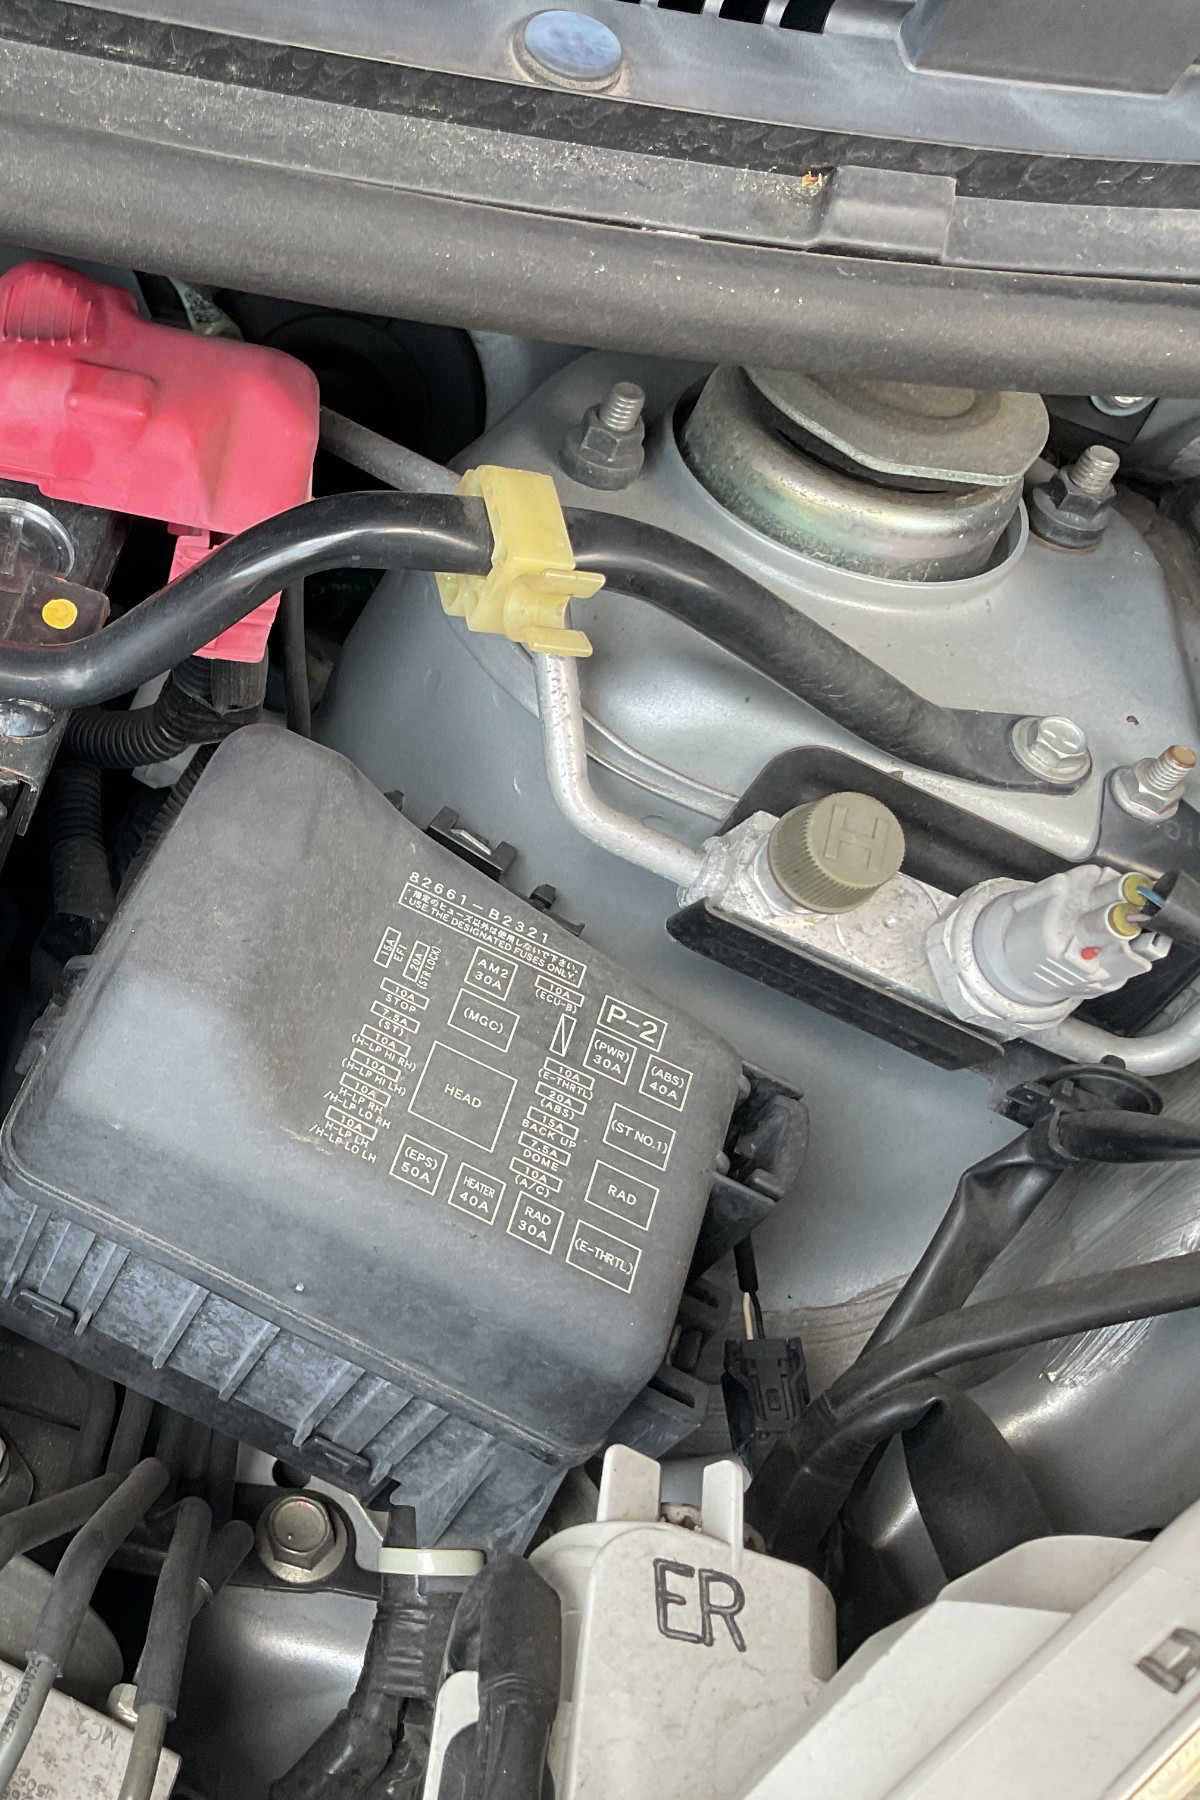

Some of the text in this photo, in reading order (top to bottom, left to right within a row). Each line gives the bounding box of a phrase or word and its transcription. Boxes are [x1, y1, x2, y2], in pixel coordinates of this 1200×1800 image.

[408, 898, 427, 913] USE
[431, 907, 449, 923] THE
[451, 916, 512, 952] DESIGNATED
[513, 945, 545, 967] FUSES
[381, 939, 396, 956] 15A
[393, 944, 408, 962] EFI
[410, 952, 423, 971] 20A
[416, 945, 441, 989] (STR LOCK)
[477, 959, 509, 979] AM2
[474, 970, 502, 990] 30A
[394, 986, 415, 1002] 10A
[535, 988, 577, 1014] (ECU-B)
[550, 983, 570, 1000] 10A
[385, 993, 417, 1013] STOP
[378, 1018, 404, 1037] (ST)
[383, 1008, 408, 1026] 7.5A
[463, 1007, 504, 1034] (MGC)
[606, 1004, 658, 1043] P-2
[375, 1033, 396, 1049] 10A
[594, 1039, 630, 1063] (PWR)
[351, 1033, 417, 1072] (H-LP HI RH)
[365, 1057, 387, 1074] 10A
[558, 1066, 580, 1082] 10A
[593, 1054, 621, 1074] 30A
[341, 1058, 406, 1097] (H-LP HI LH)
[538, 1068, 593, 1101] (E-THRTL)
[651, 1066, 685, 1088] (ABS)
[339, 1086, 383, 1114] H-LP RH
[355, 1082, 376, 1098] 10A
[443, 1083, 482, 1108] HEAD
[549, 1090, 572, 1107] 20A
[649, 1082, 677, 1100] 40A
[323, 1090, 391, 1129] /H-LP LO RH
[540, 1097, 575, 1120] (ABS)
[324, 1121, 369, 1148] H-LP LH
[341, 1115, 362, 1132] 10A
[522, 1118, 577, 1149] BACK UP
[542, 1115, 564, 1132] 15A
[309, 1124, 377, 1163] /H-LP LO LH
[611, 1119, 668, 1154] (ST NO.1)
[404, 1146, 438, 1170] (EPS)
[531, 1138, 558, 1158] 7.5A
[523, 1149, 559, 1172] DOME
[401, 1161, 430, 1183] 50A
[525, 1166, 547, 1183] 10A
[463, 1175, 496, 1199] HEATER
[515, 1174, 550, 1198] (A/C)
[607, 1184, 637, 1206] RAD
[459, 1191, 489, 1213] 40A
[524, 1205, 552, 1226] RAD
[518, 1220, 547, 1242] 30A
[574, 1237, 634, 1276] (E-THRTL)
[653, 1557, 747, 1653] ER
